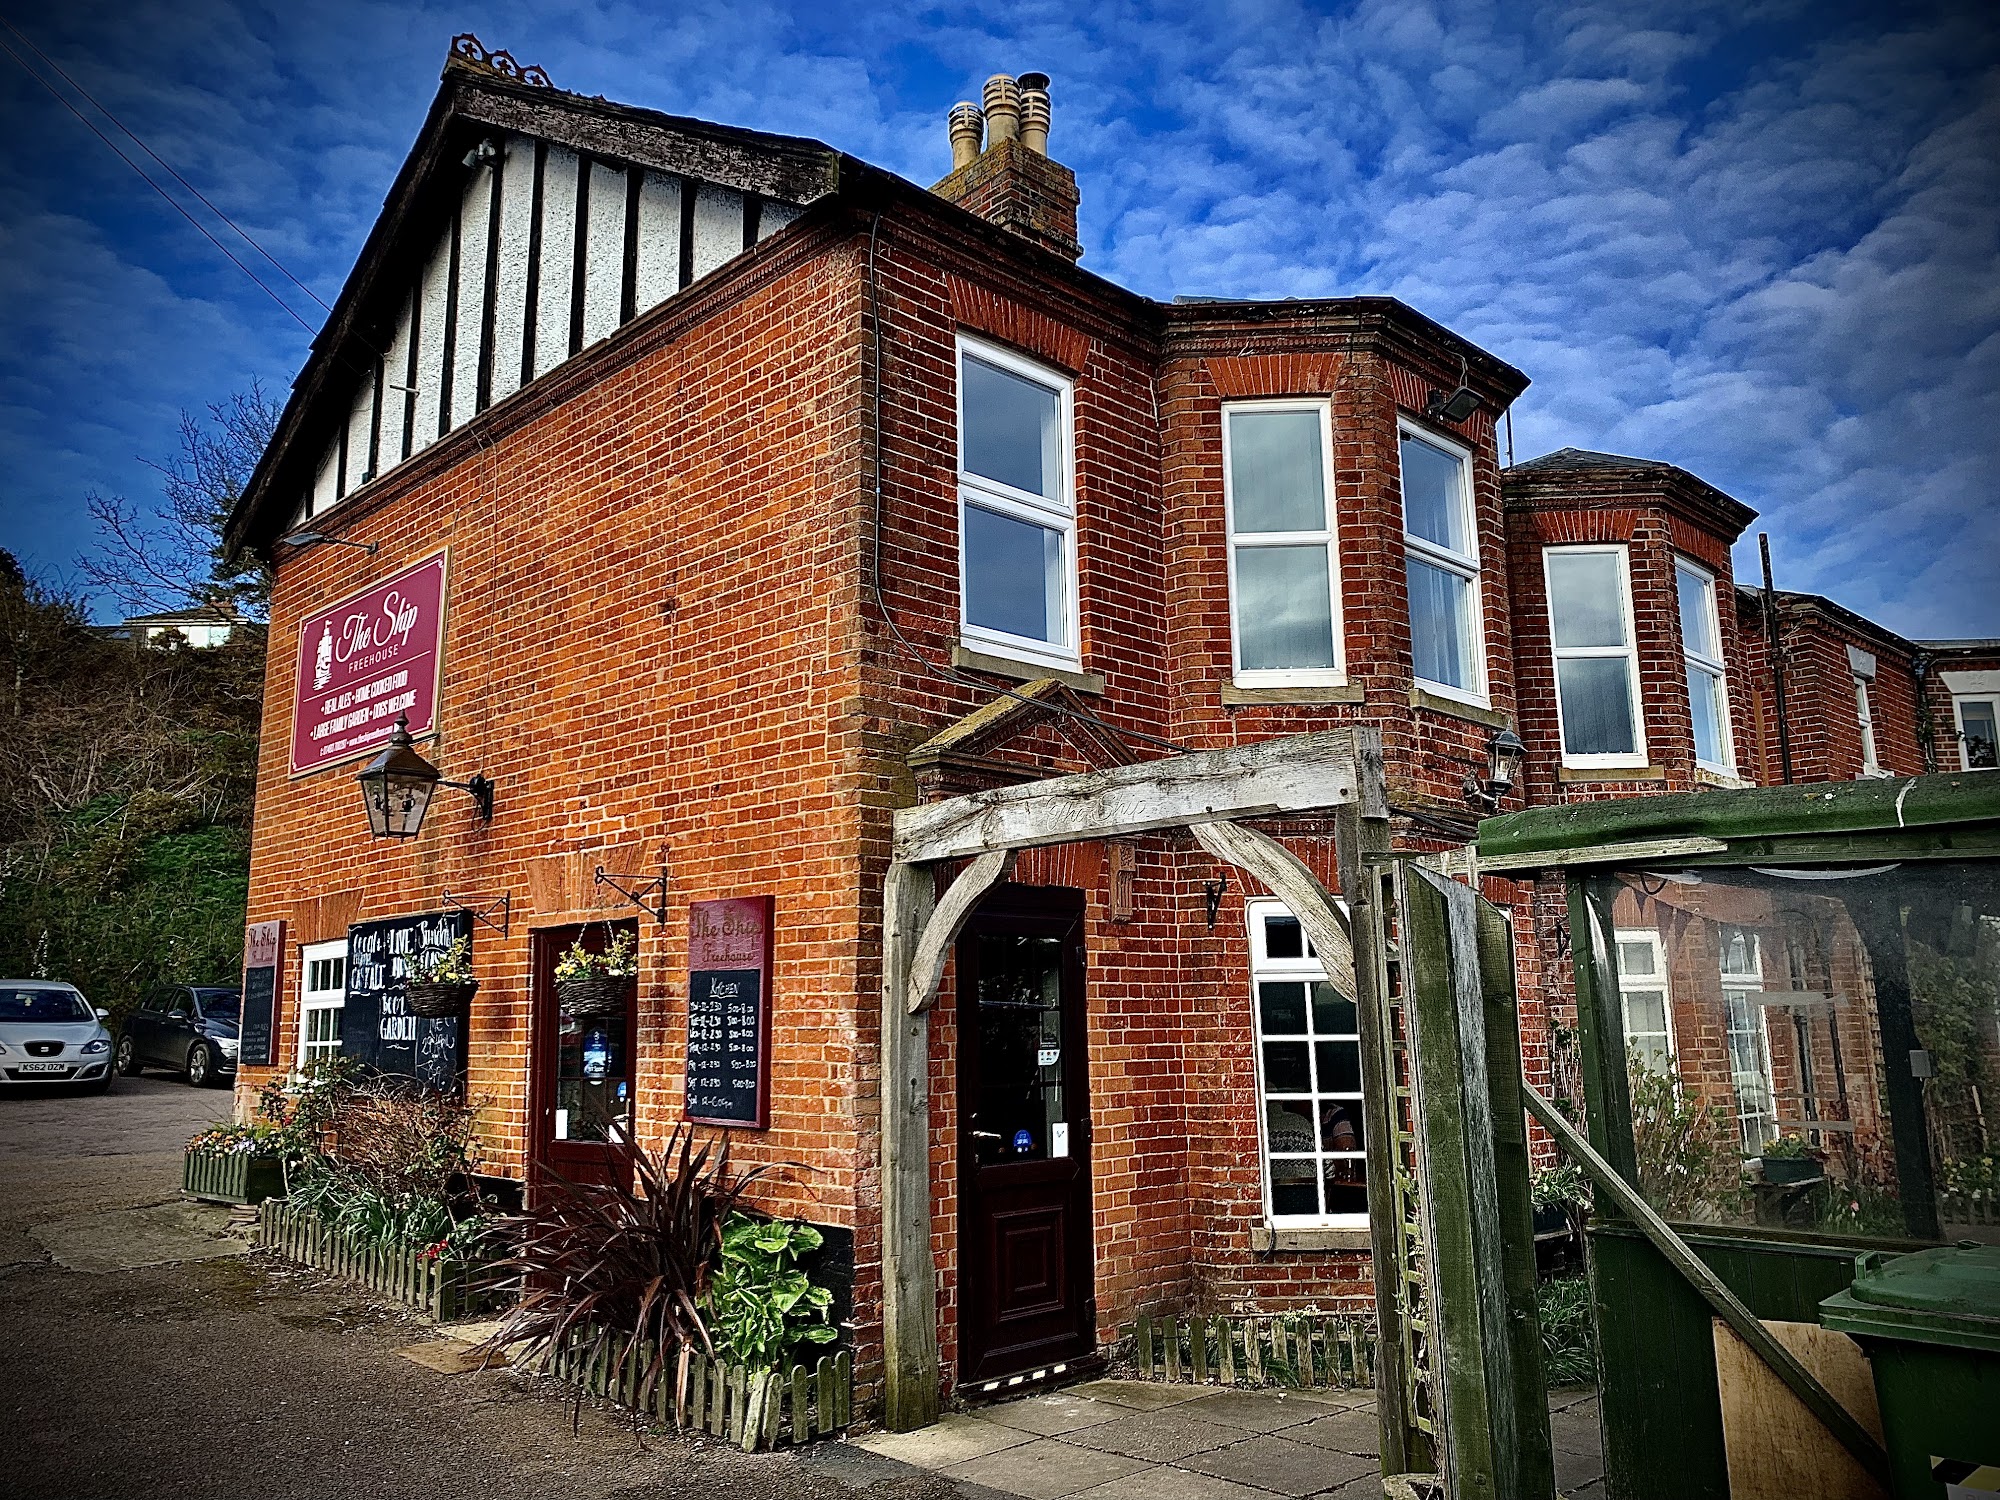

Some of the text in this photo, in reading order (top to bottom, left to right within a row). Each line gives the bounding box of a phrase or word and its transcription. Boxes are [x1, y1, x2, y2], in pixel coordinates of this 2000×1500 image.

[336, 591, 418, 662] The Ship
[348, 644, 399, 674] FREEHOUSE
[324, 670, 409, 715] REAL ALES HOME COOKED FOOD
[313, 689, 417, 740] LARGE FAMILY GARDEN DOGS WELCOME
[1046, 791, 1146, 831] The Ship
[389, 927, 414, 954] LIVE
[690, 904, 762, 949] The Ship
[380, 1016, 417, 1041] GARDEN
[22, 1063, 46, 1071] KS62
